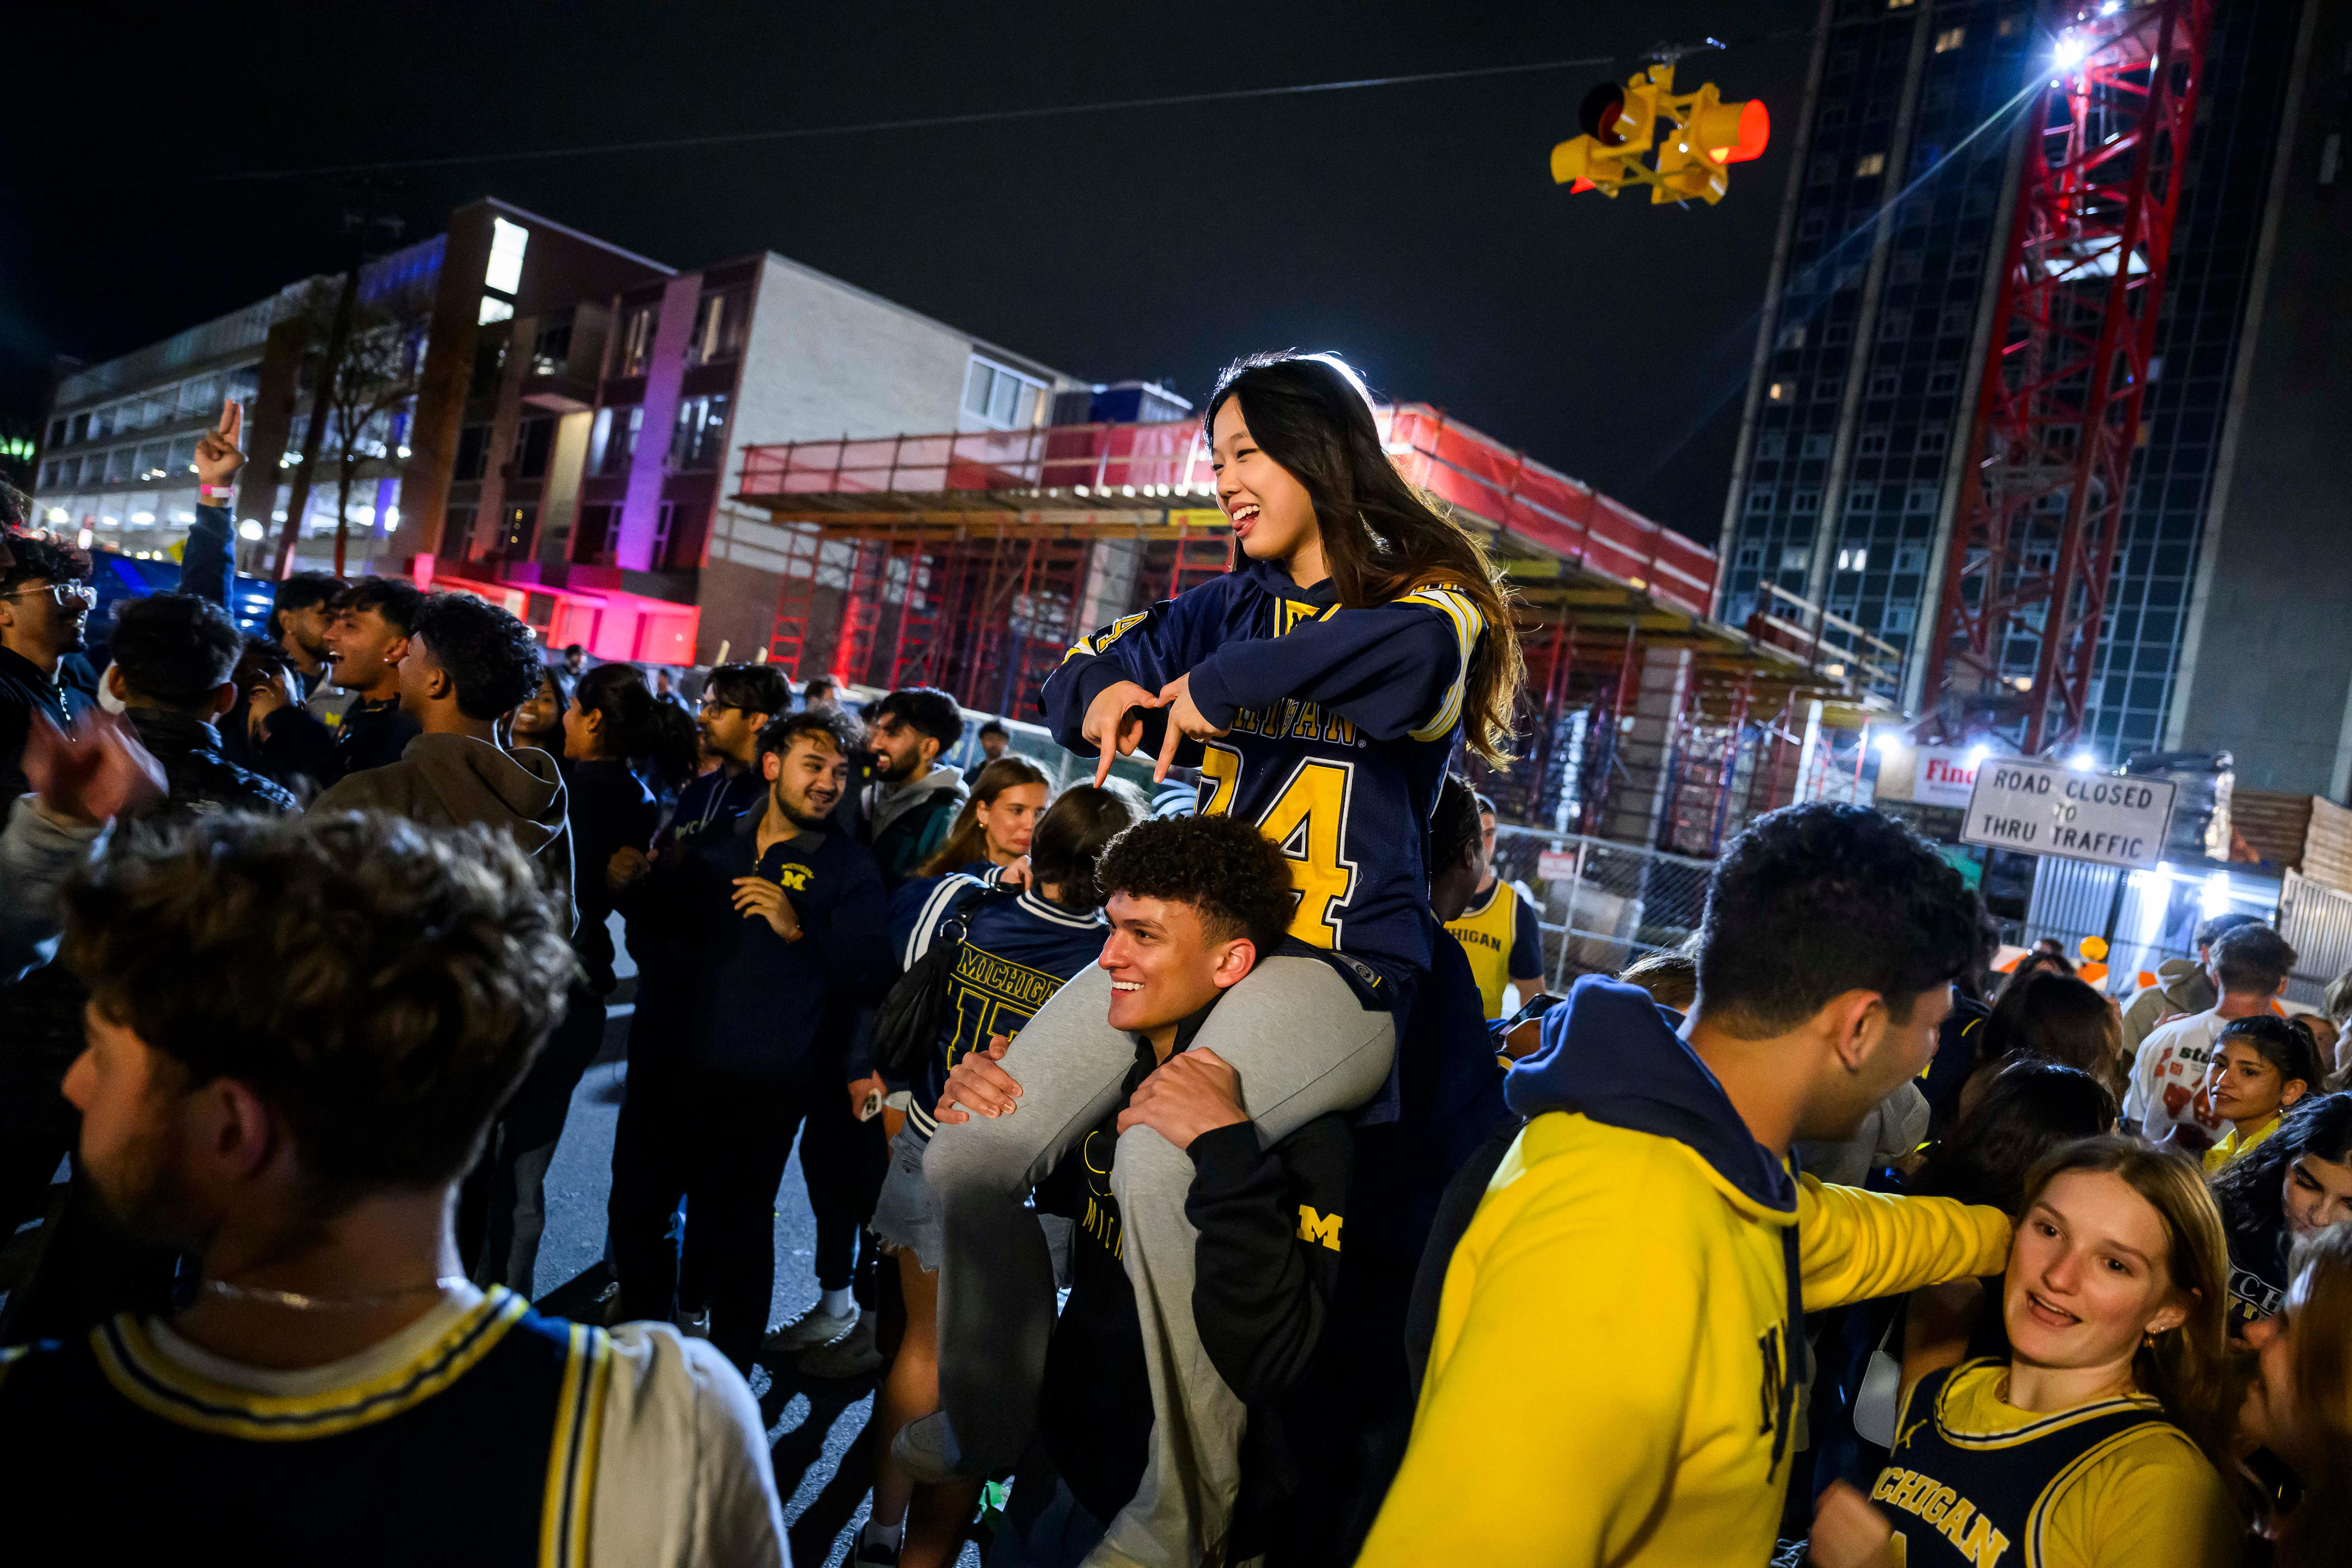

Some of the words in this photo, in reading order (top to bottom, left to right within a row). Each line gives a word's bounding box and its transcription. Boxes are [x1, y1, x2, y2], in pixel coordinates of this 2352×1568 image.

[1993, 769, 2051, 795] ROAD
[2066, 780, 2153, 810] CLOSED
[2055, 802, 2077, 823] TO
[1983, 814, 2037, 842] THRU
[2052, 825, 2143, 859] TRAFFIC
[781, 870, 806, 891] M
[1444, 928, 1501, 952] HIGAN
[1297, 1204, 1343, 1252] M
